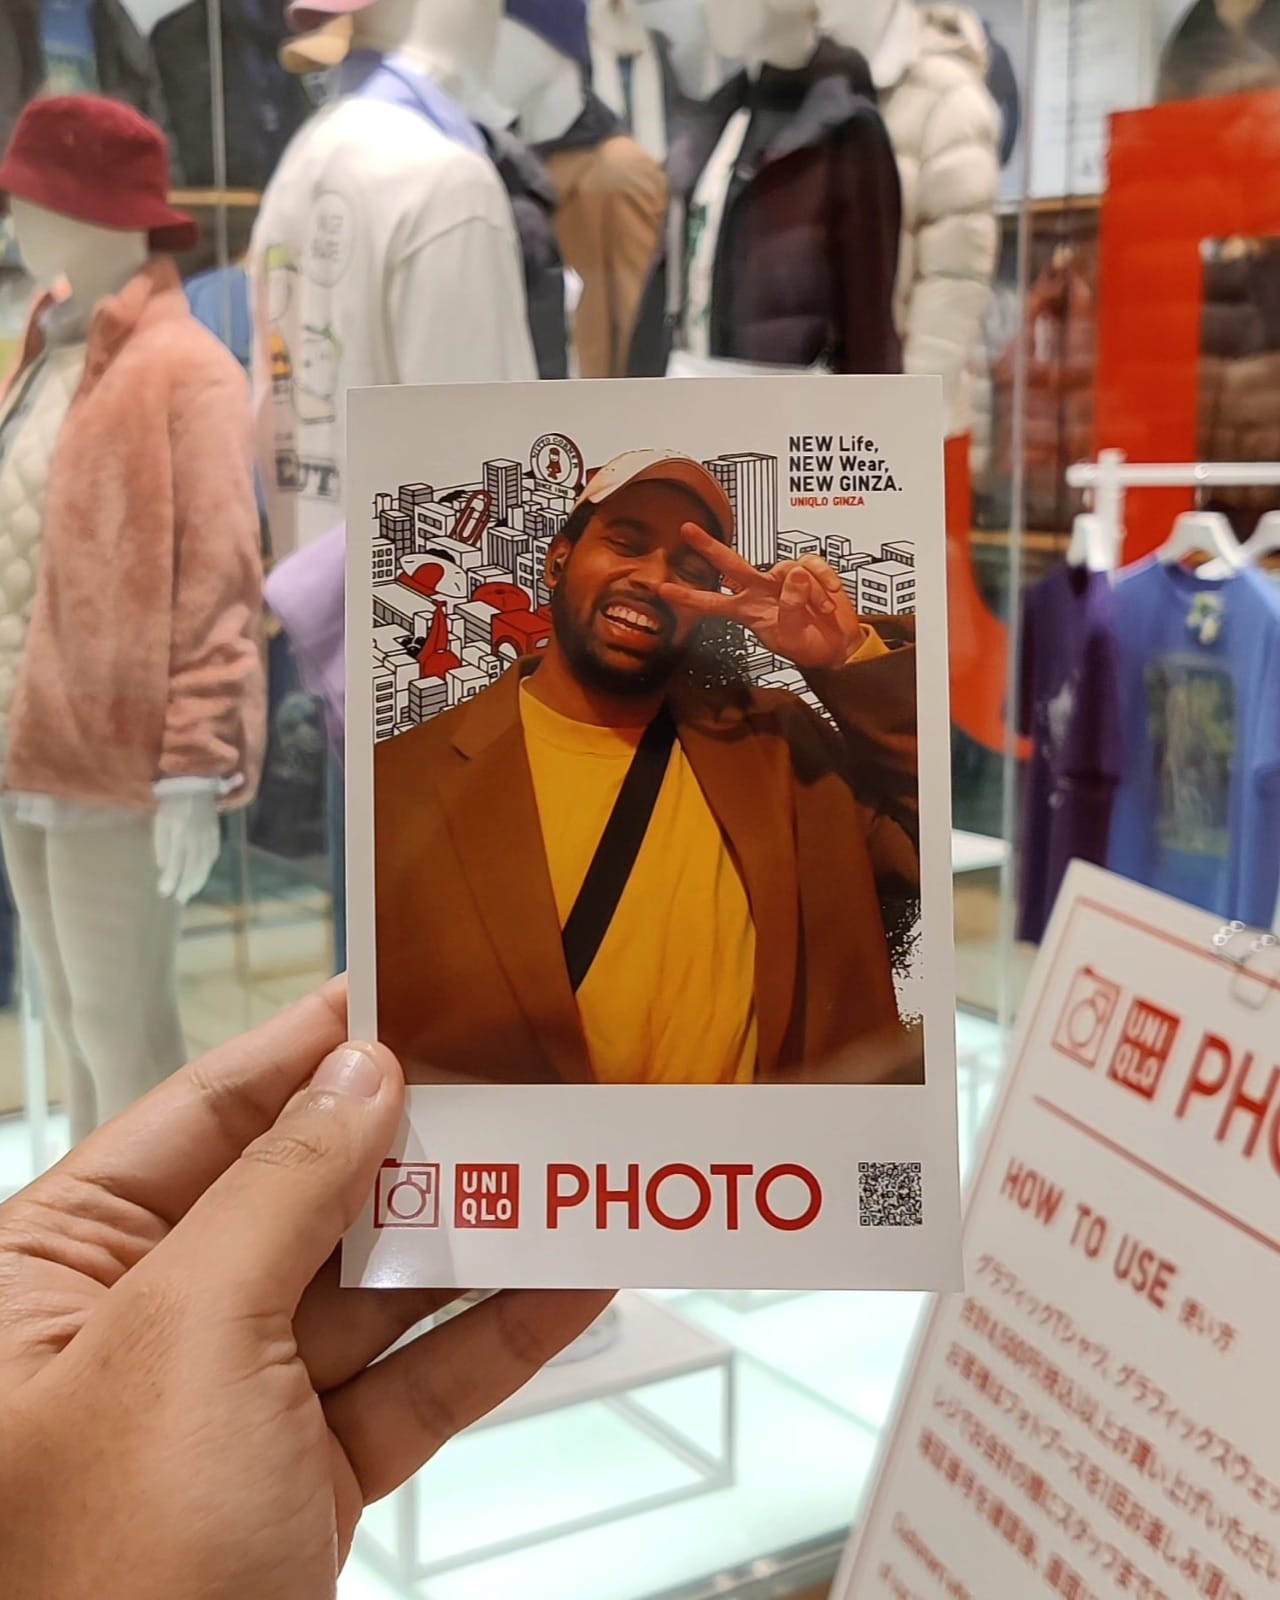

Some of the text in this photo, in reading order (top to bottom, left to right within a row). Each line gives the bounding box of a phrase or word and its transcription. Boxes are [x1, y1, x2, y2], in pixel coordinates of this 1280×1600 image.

[789, 435, 879, 454] NEW Life,
[789, 455, 889, 473] NEW Wear,
[789, 475, 903, 492] NEW GINZA.
[790, 496, 865, 508] UNIQLO GINZA
[1129, 1009, 1170, 1052] UNI
[1113, 1049, 1160, 1090] QLO
[462, 1162, 823, 1230] UNI PHOTO
[462, 1197, 512, 1222] QLO
[999, 1157, 1065, 1227] HOW
[1069, 1202, 1110, 1260] TO
[1112, 1233, 1180, 1310] USE
